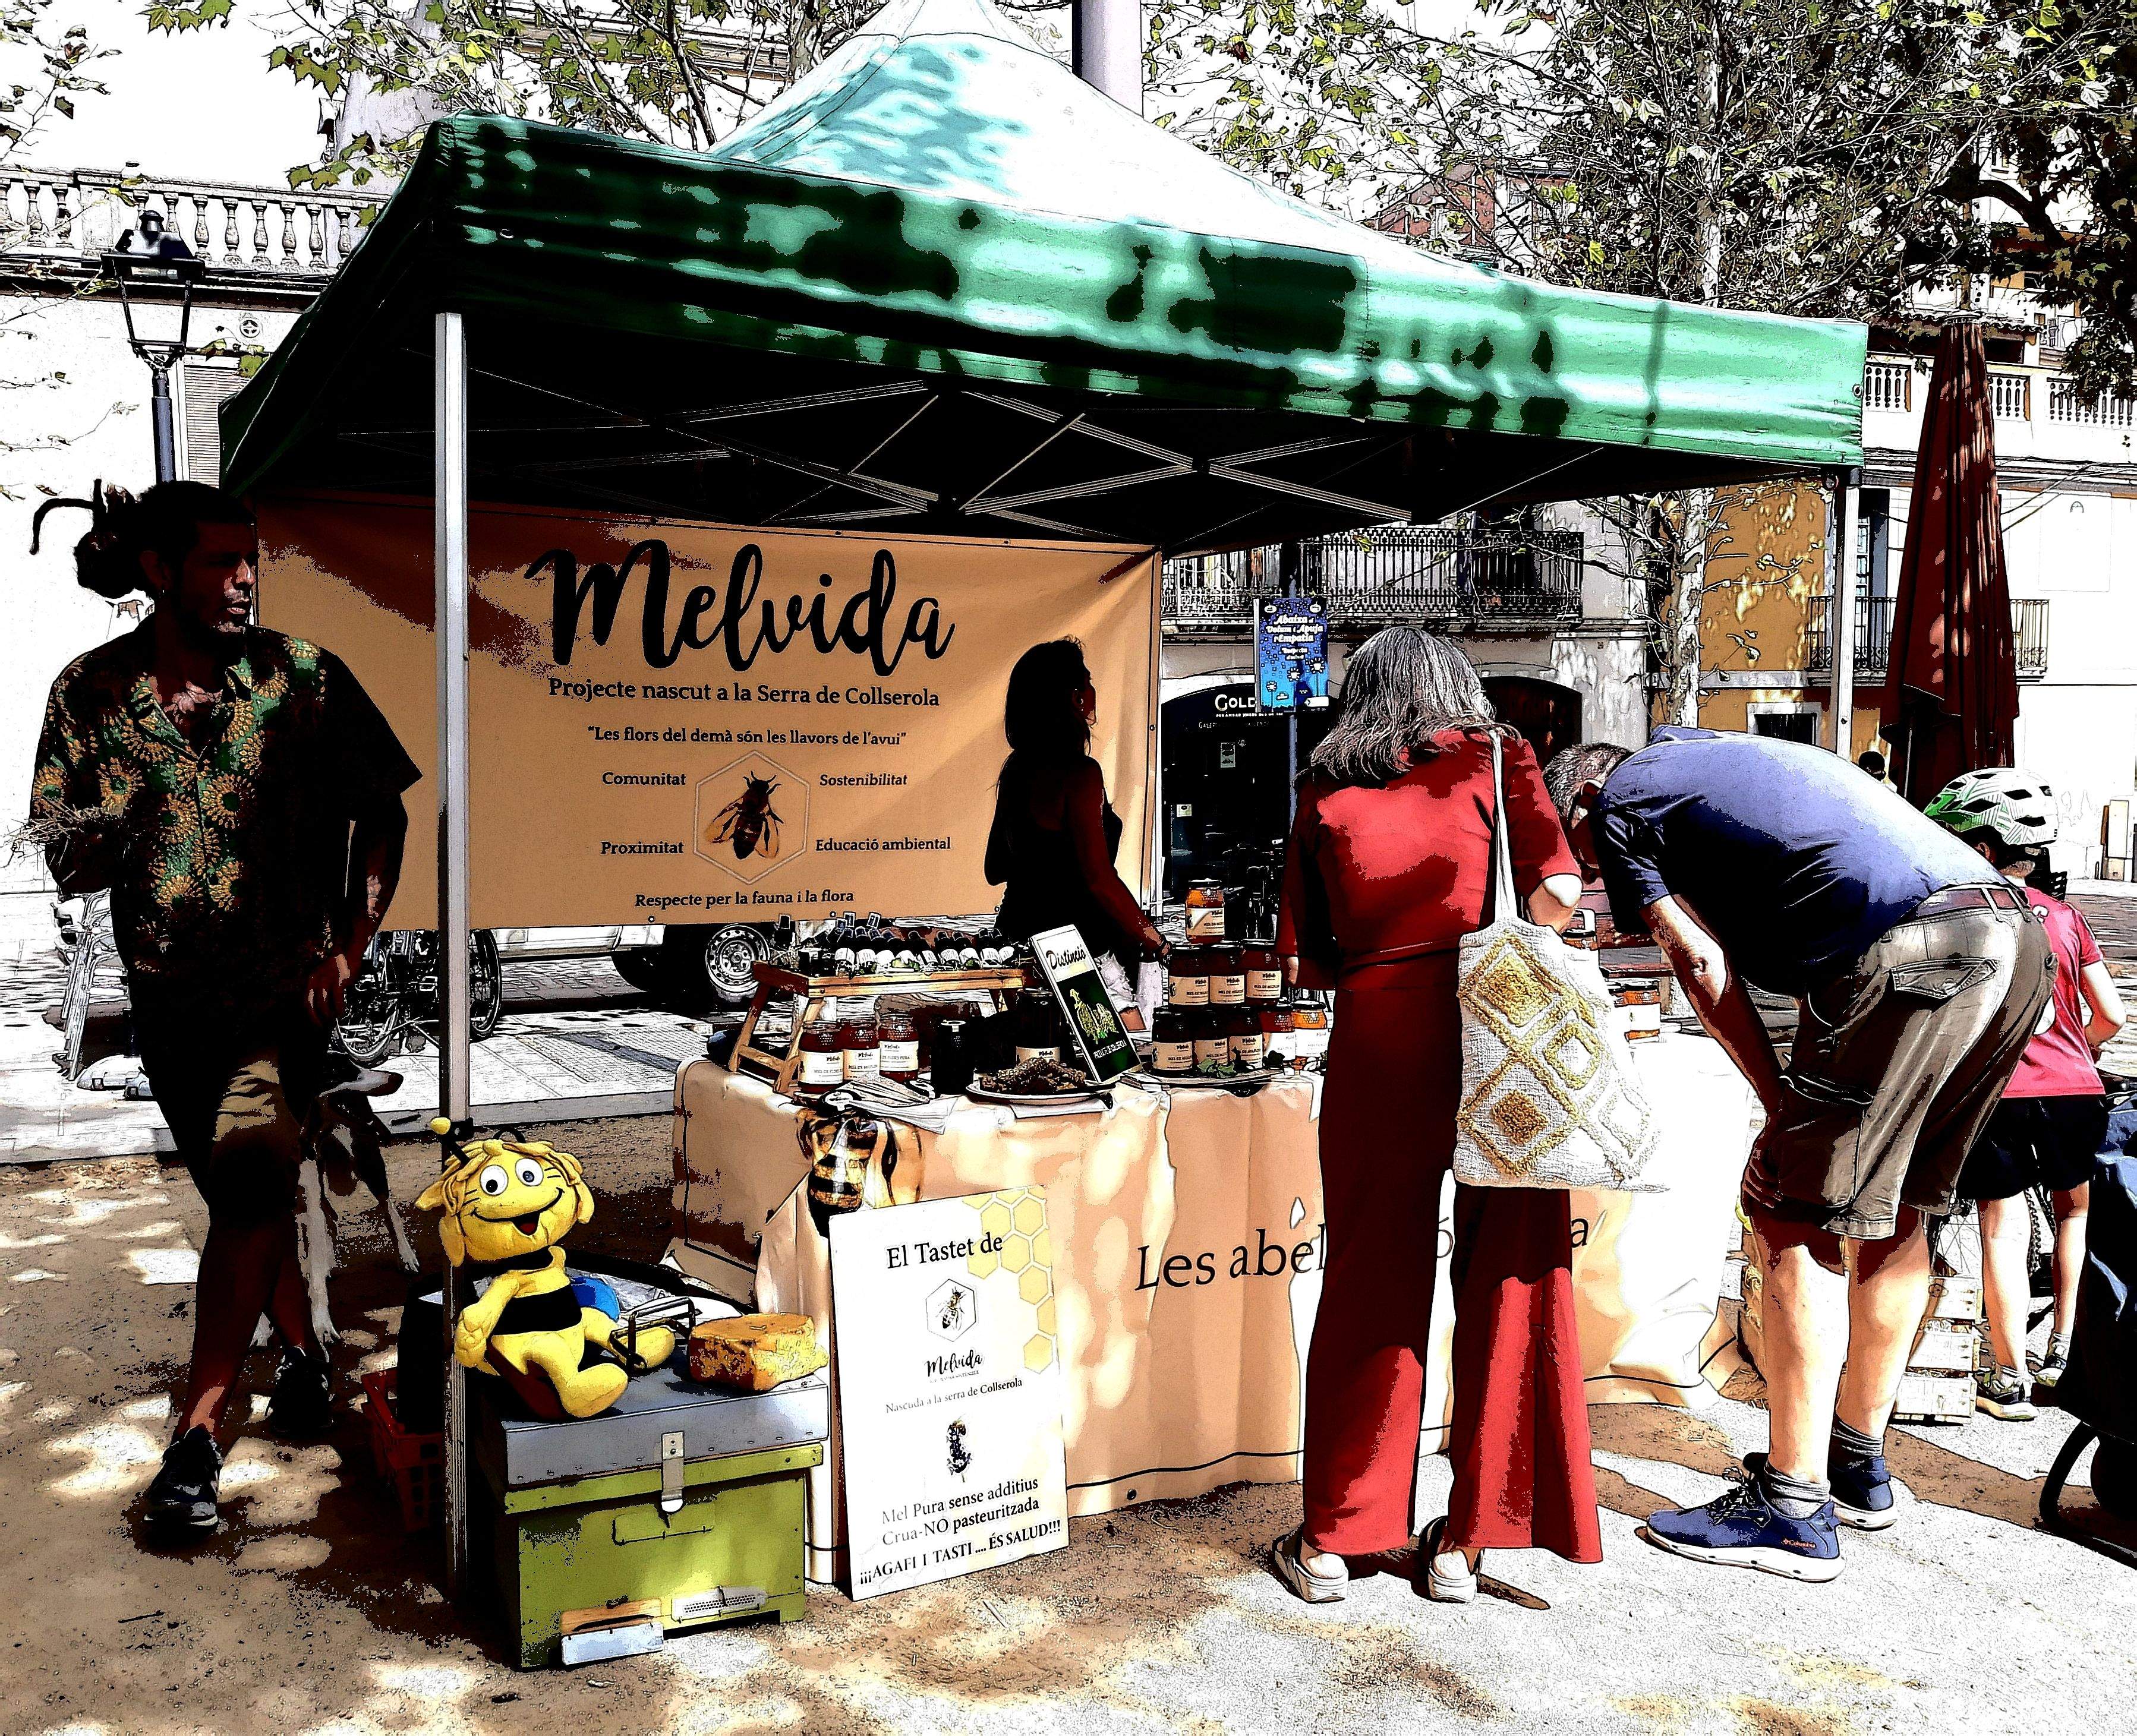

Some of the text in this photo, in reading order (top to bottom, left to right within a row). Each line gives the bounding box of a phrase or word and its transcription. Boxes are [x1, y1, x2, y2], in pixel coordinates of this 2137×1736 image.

[524, 539, 955, 677] Melvida
[547, 676, 940, 706] Projecte nascut a la Serra de Collserola
[624, 727, 658, 741] flors
[663, 727, 686, 741] del
[691, 728, 733, 742] demà
[737, 730, 763, 744] són
[767, 730, 786, 743] les
[790, 730, 839, 744] llavors
[843, 731, 859, 744] de
[603, 772, 686, 785] Comunitat
[820, 774, 907, 785] Sostenibilitat
[601, 841, 684, 856] Proximitat
[816, 837, 951, 851] Educació ambiental
[635, 889, 854, 910] Respecte per la fauna i la flora
[1046, 945, 1086, 970] Distinció
[887, 1232, 1003, 1268] El Tastet de
[1135, 1223, 1325, 1291] Les abel
[924, 1349, 983, 1377] Melvida
[886, 1399, 923, 1413] Nascuda
[934, 1394, 941, 1403] la
[945, 1391, 965, 1401] serra
[968, 1387, 978, 1396] de
[981, 1378, 1022, 1393] Collserola
[882, 1479, 1038, 1524] Mel Pura sense additius
[883, 1496, 1039, 1544] Crua-NO pasteuritzada
[923, 1554, 927, 1566] I
[989, 1533, 1003, 1549] ÉS
[1006, 1520, 1060, 1545] SALUD!!!
